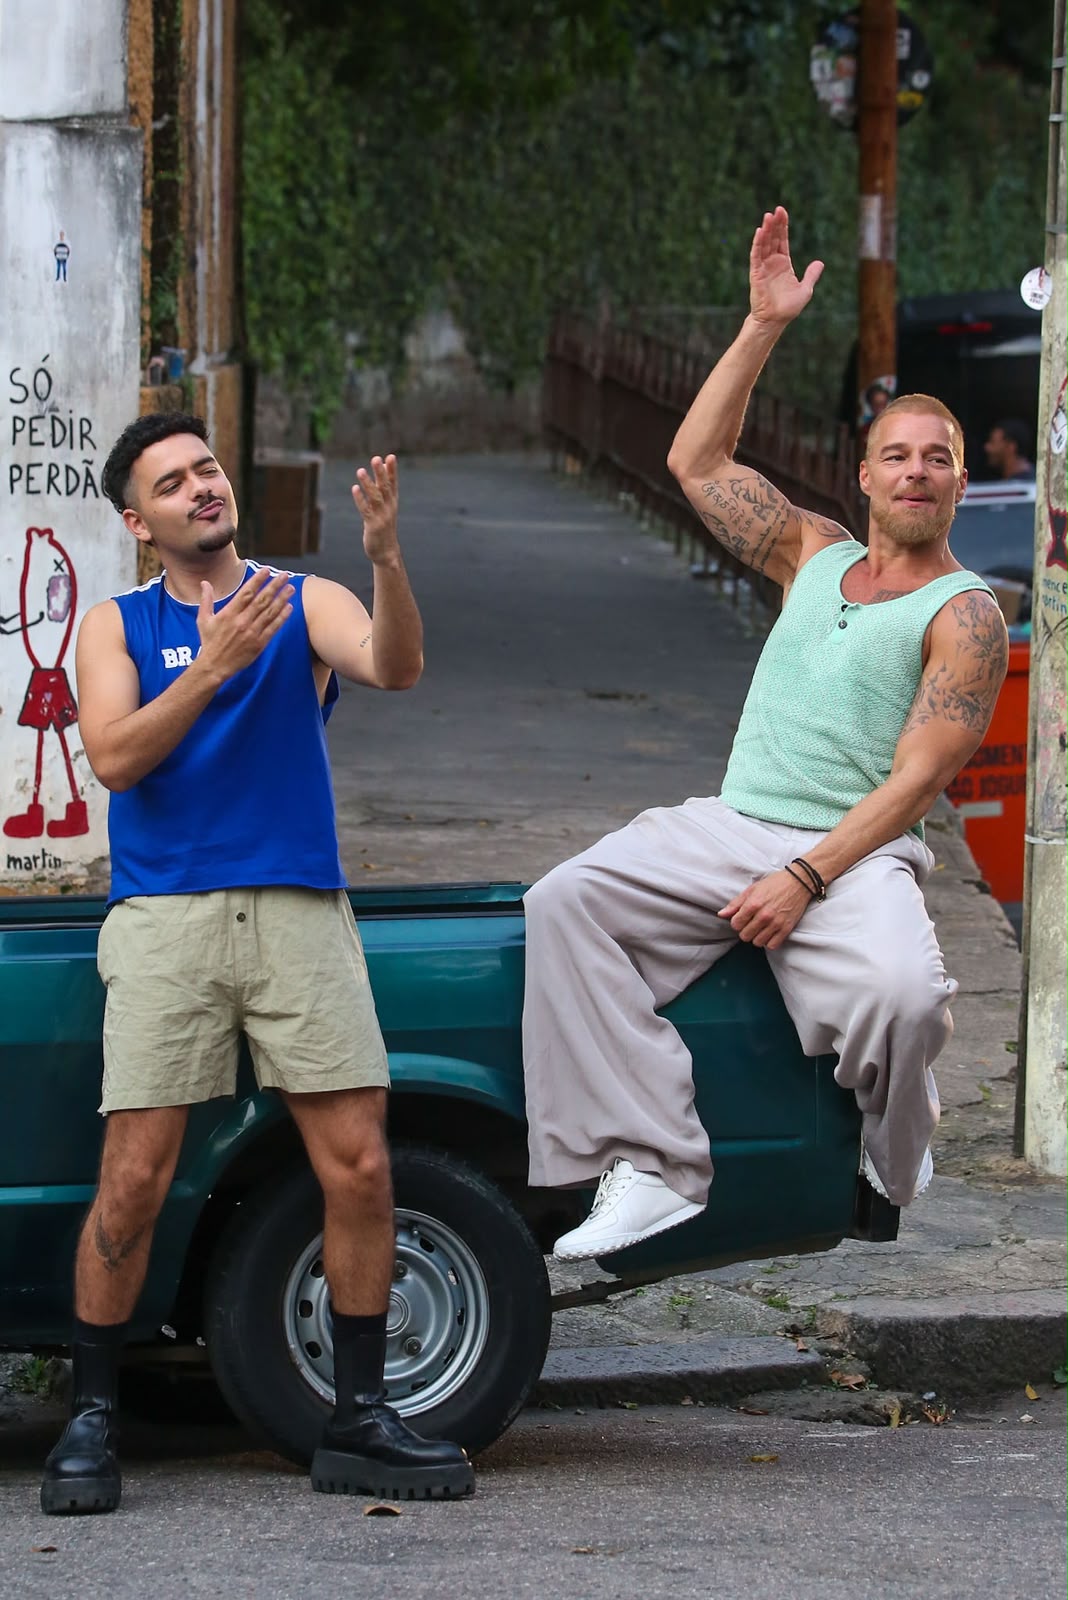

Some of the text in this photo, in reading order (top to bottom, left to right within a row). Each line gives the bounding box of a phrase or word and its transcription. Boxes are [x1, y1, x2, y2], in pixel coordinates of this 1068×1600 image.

[9, 353, 53, 404] SÓ
[12, 409, 97, 451] PEDIR
[161, 645, 201, 669] BR
[6, 848, 62, 871] martin
